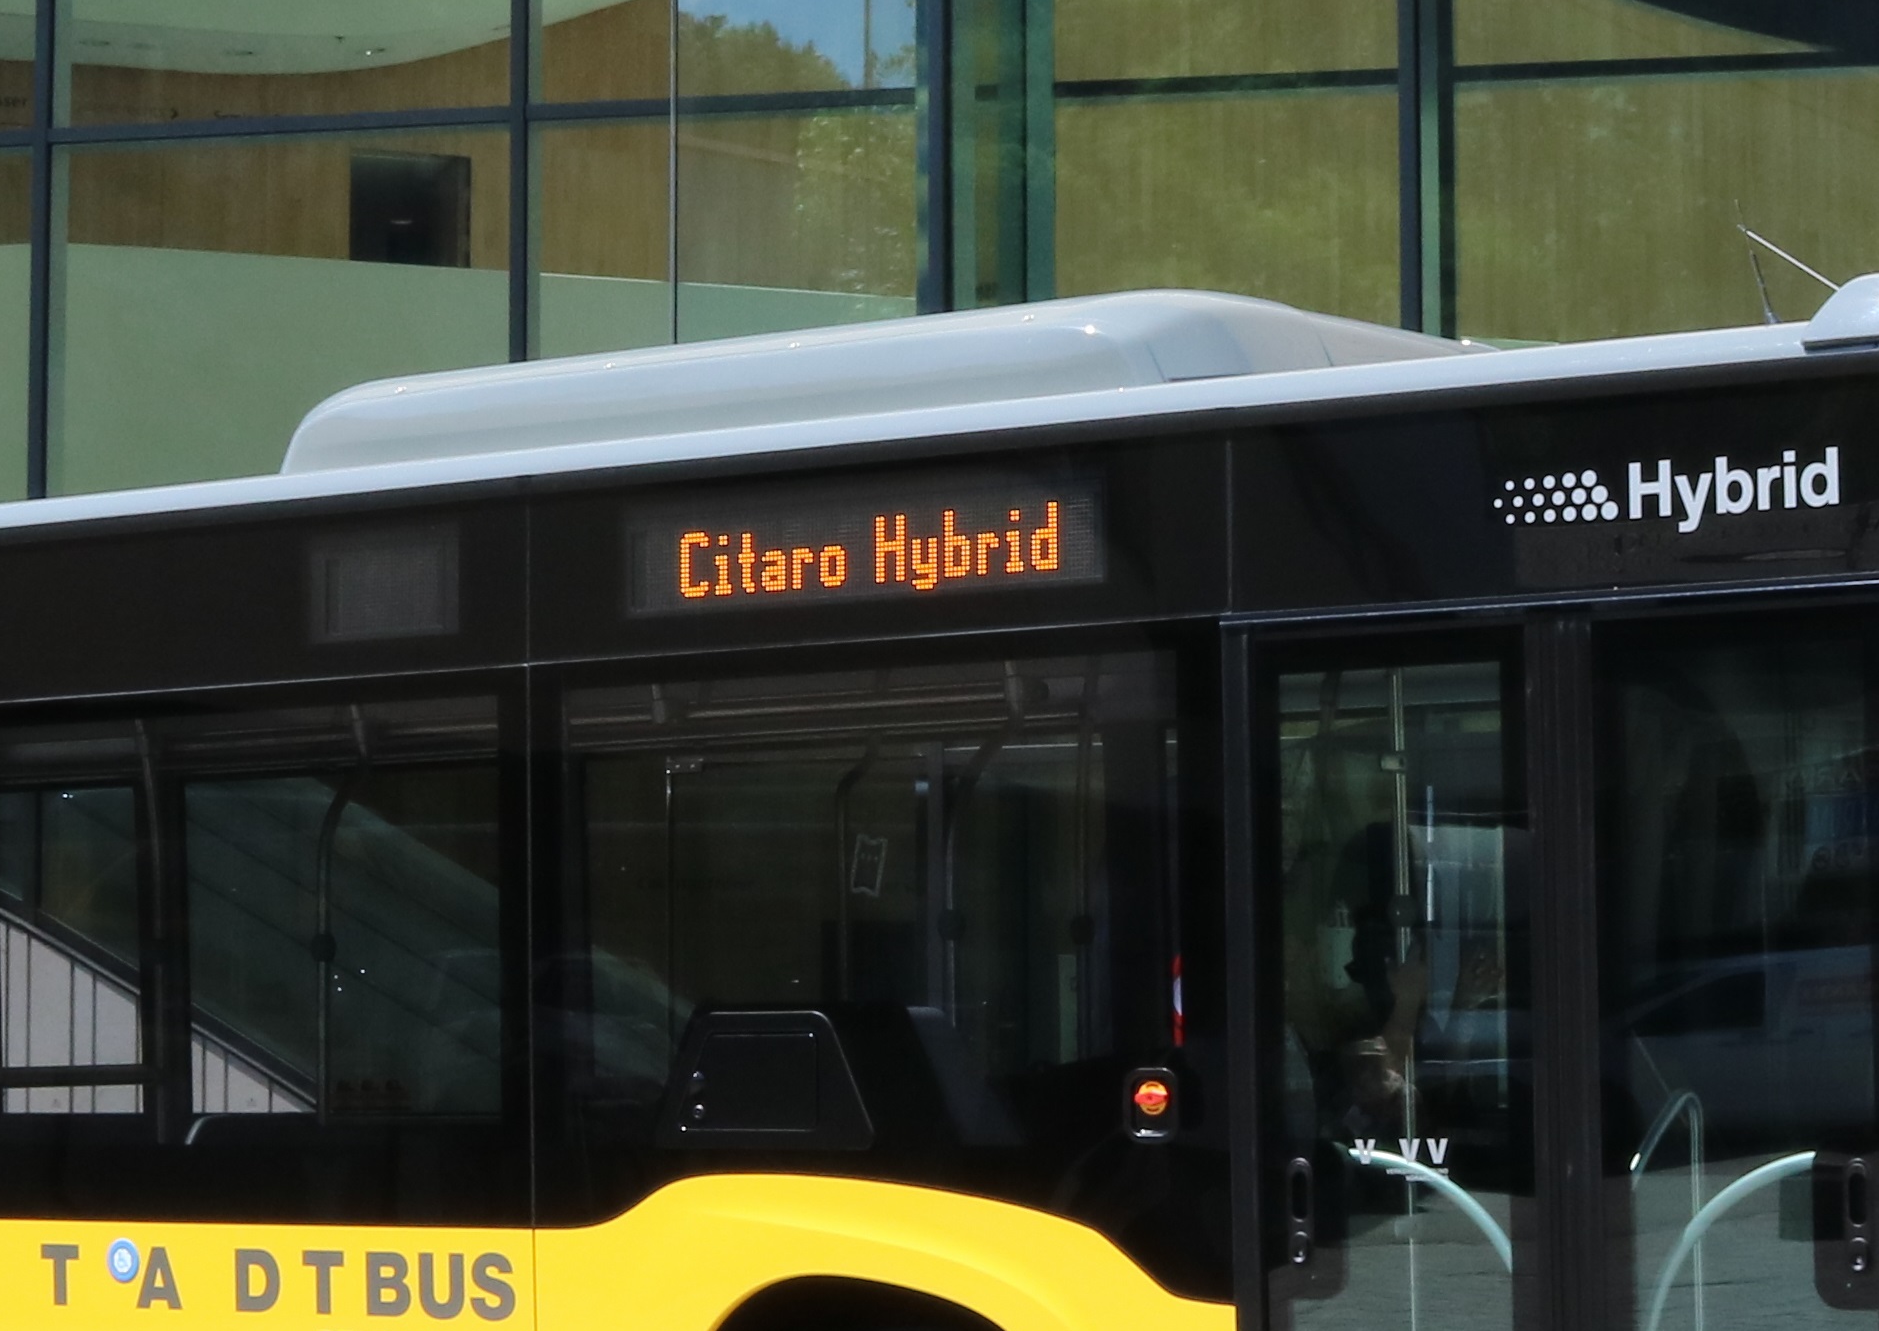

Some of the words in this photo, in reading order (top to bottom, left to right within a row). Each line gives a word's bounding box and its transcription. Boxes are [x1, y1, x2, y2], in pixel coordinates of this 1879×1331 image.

[1627, 445, 1840, 533] Hybrid
[677, 530, 848, 599] Citaro
[873, 500, 1060, 591] Hybrid
